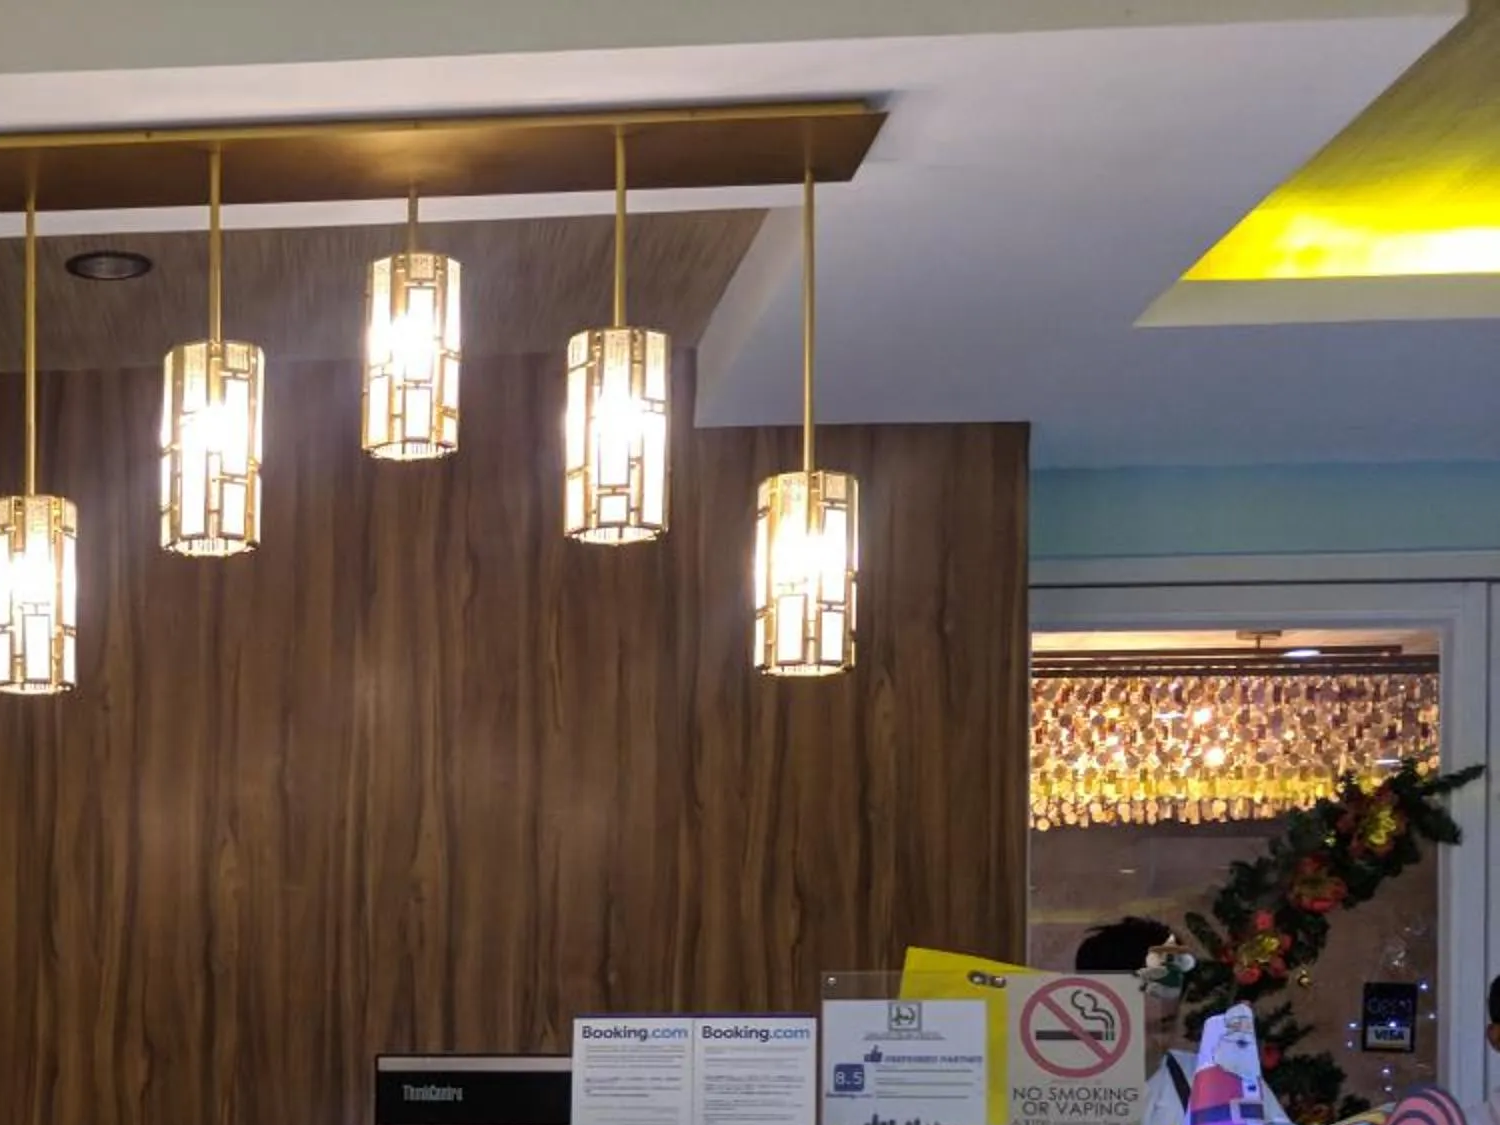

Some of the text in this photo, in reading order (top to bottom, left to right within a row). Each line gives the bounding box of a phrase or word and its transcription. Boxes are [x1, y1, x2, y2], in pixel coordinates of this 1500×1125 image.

[582, 1025, 688, 1042] Booking.com
[701, 1025, 810, 1043] Booking.com
[835, 1071, 863, 1085] 8.5
[1013, 1087, 1139, 1101] NO SMOKING
[1022, 1102, 1130, 1117] OR VAPING
